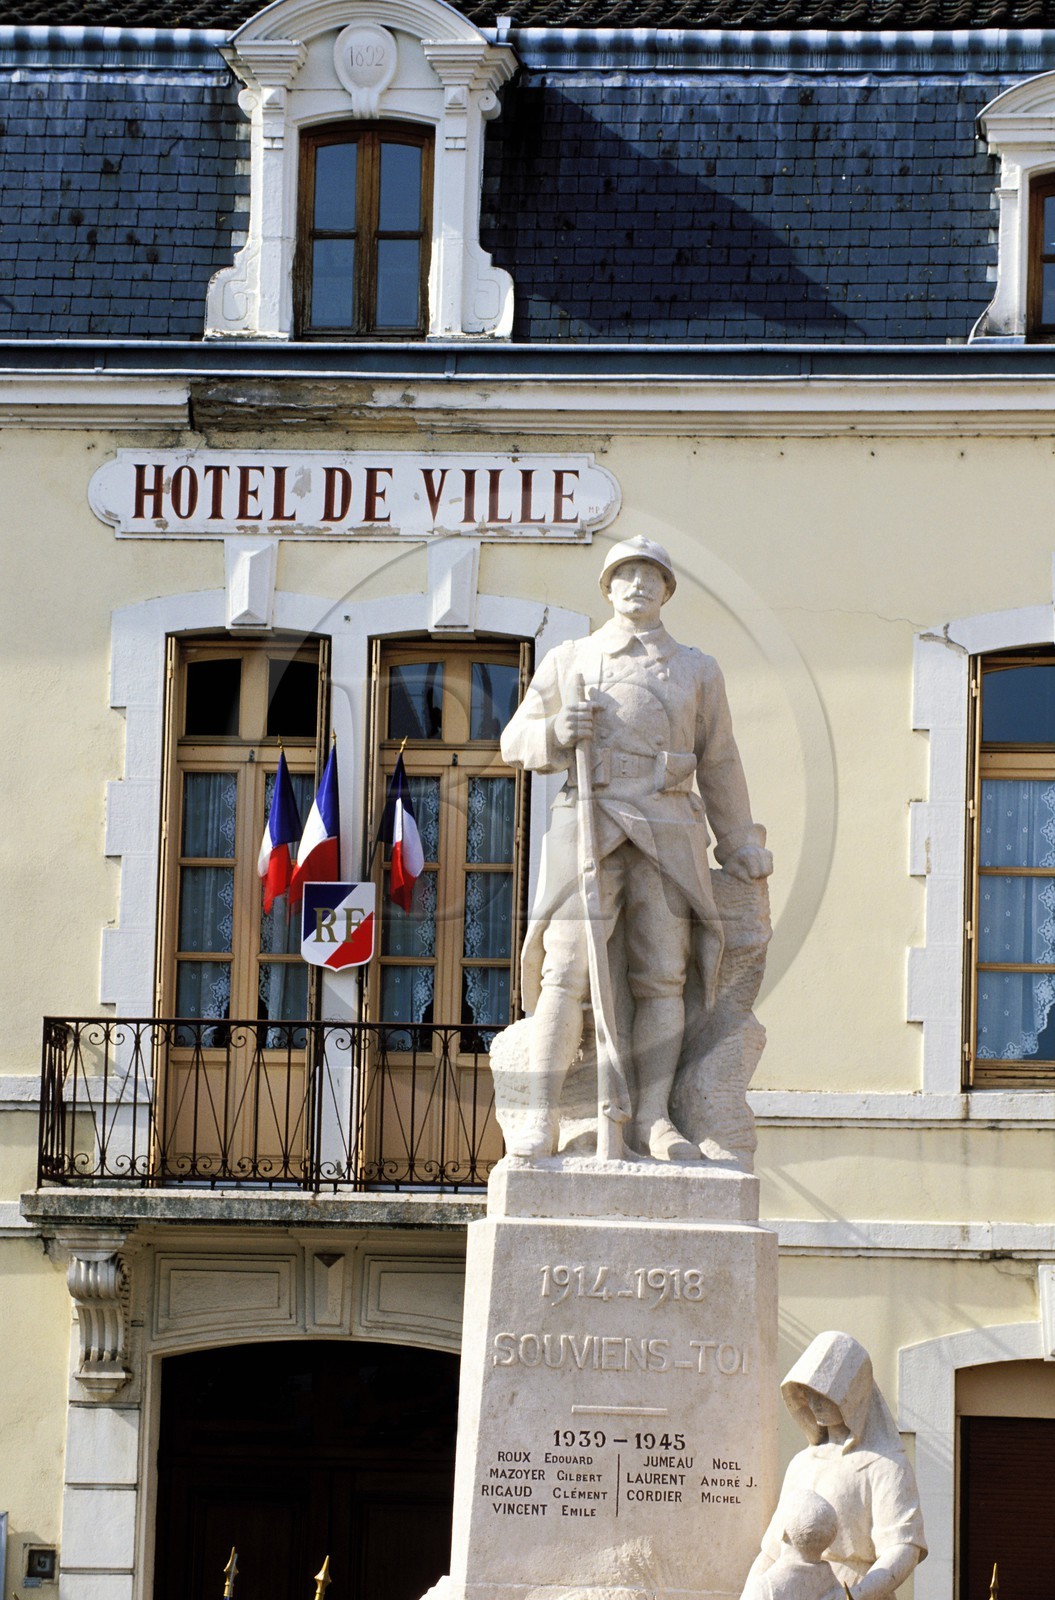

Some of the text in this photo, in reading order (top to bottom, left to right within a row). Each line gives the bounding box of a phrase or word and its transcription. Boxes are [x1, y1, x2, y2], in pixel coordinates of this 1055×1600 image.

[132, 463, 581, 524] HOTEL DE VILLE
[312, 907, 366, 943] RF
[492, 1331, 749, 1376] SOUVIENS-TOI
[552, 1429, 607, 1448] 1939
[634, 1432, 687, 1451] 1945
[497, 1451, 594, 1466] ROUX EDOUARD
[643, 1455, 742, 1471] JUMEAU NOEL
[489, 1468, 603, 1482] MAZOYER GILBERT
[626, 1472, 758, 1488] LAURENT ANDRÉ J.
[481, 1484, 609, 1501] RIGAUD CLÉMENT
[626, 1489, 742, 1504] CORDIER MICHEL
[492, 1503, 597, 1517] VINCENT EMILE
